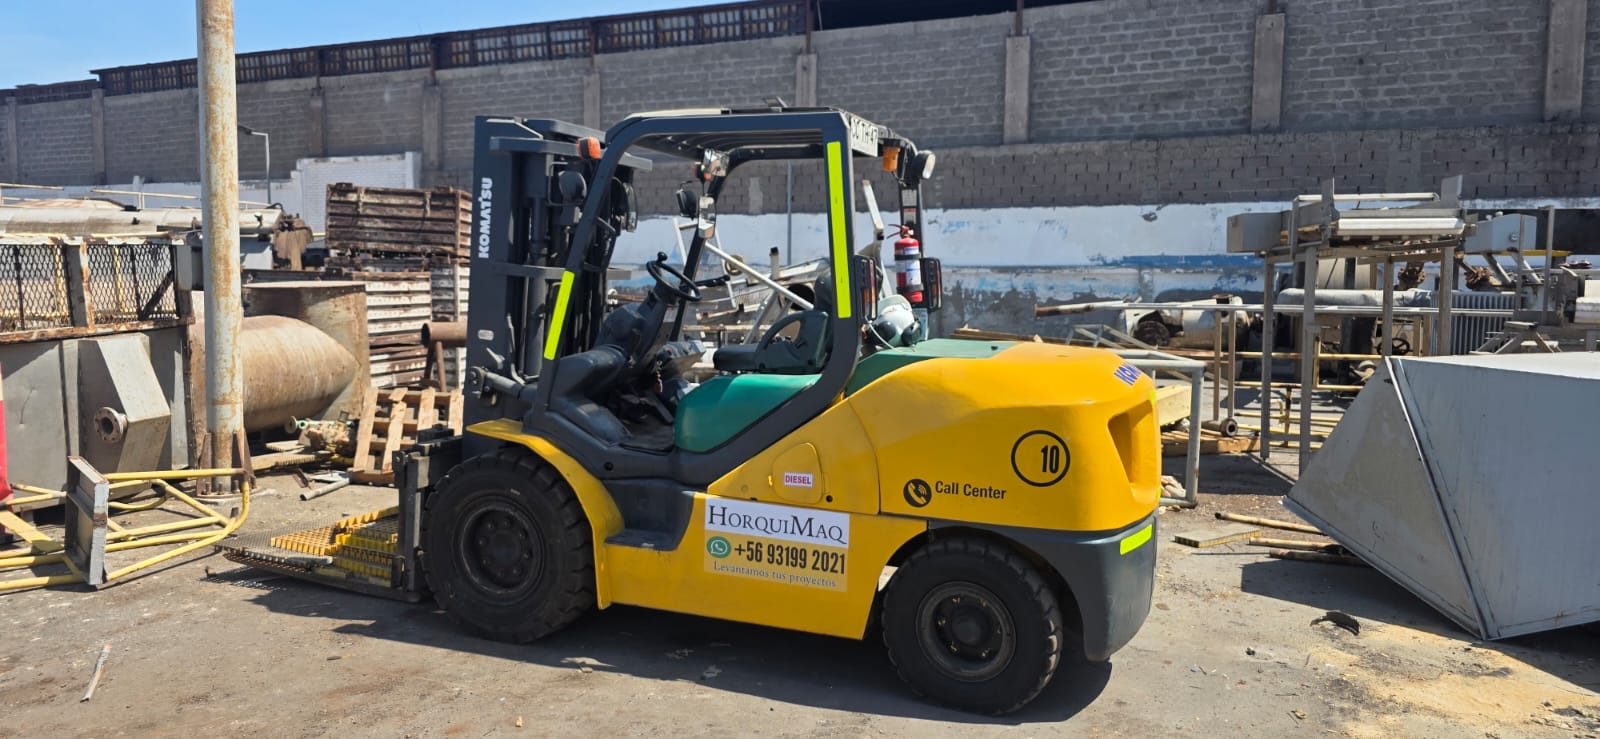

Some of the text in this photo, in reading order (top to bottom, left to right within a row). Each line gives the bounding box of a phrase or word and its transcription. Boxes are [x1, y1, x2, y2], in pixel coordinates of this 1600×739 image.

[478, 177, 493, 259] KOMATSU
[1040, 444, 1060, 474] 10
[785, 475, 811, 485] DIESEL
[935, 480, 1007, 500] Call Center
[734, 540, 846, 575] +56 93199 2021
[713, 560, 837, 588] Levantamos tus proyectos
